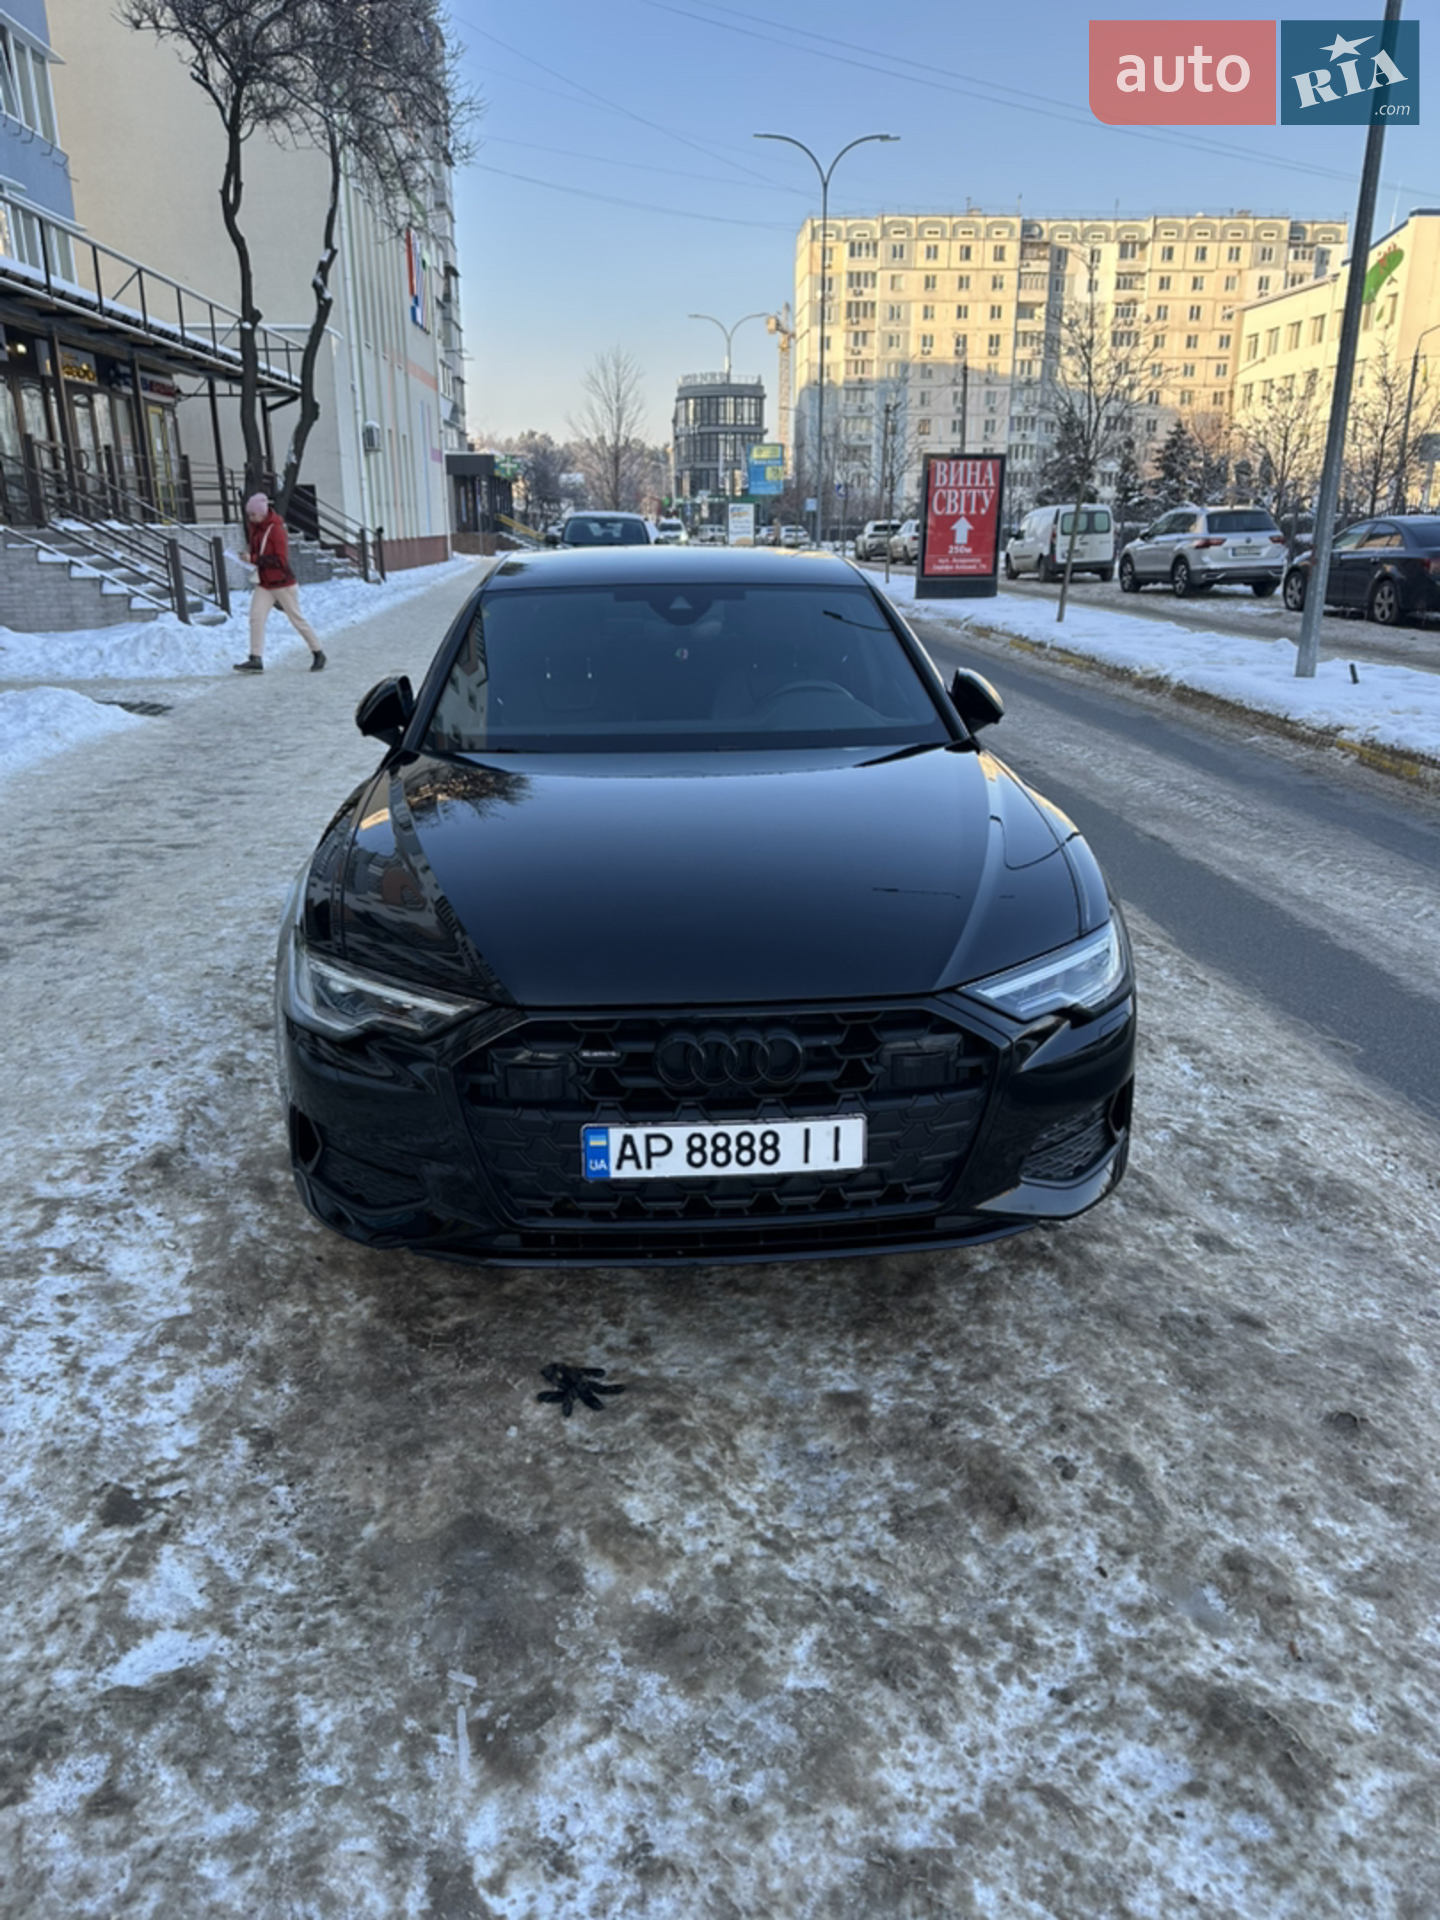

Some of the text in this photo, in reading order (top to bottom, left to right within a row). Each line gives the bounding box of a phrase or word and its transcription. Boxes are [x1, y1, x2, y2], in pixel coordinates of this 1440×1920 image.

[935, 461, 996, 488] ВИНА
[932, 488, 995, 516] СВІТУ
[615, 1133, 673, 1171] AP
[686, 1130, 781, 1169] 8888
[589, 1159, 608, 1171] UA
